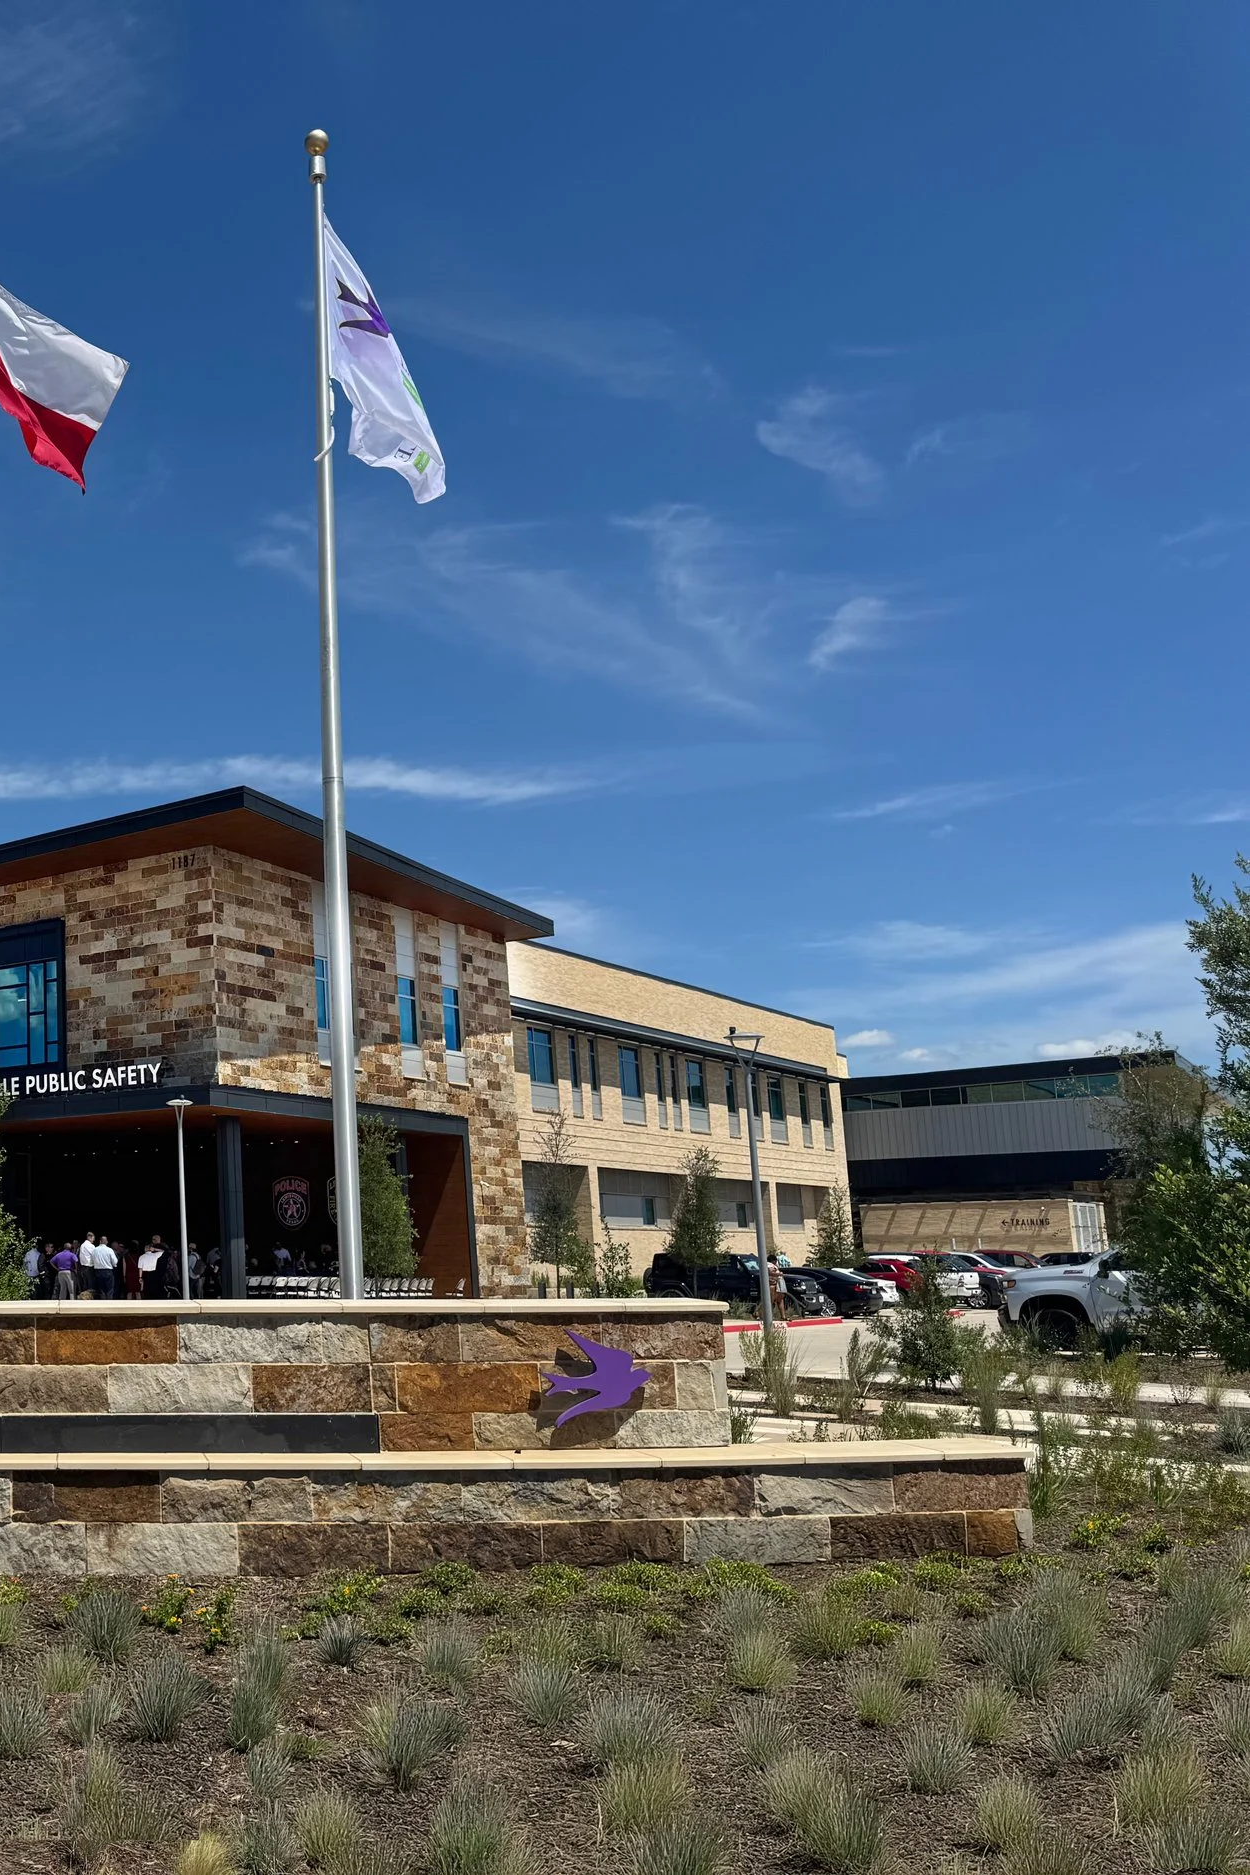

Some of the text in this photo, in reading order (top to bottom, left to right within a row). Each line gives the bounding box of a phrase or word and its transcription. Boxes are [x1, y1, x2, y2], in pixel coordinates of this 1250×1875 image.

[25, 1070, 86, 1095] PUBLIC
[92, 1063, 161, 1088] SAFETY
[274, 1179, 308, 1196] POLICE
[1010, 1218, 1050, 1226] TRAINING
